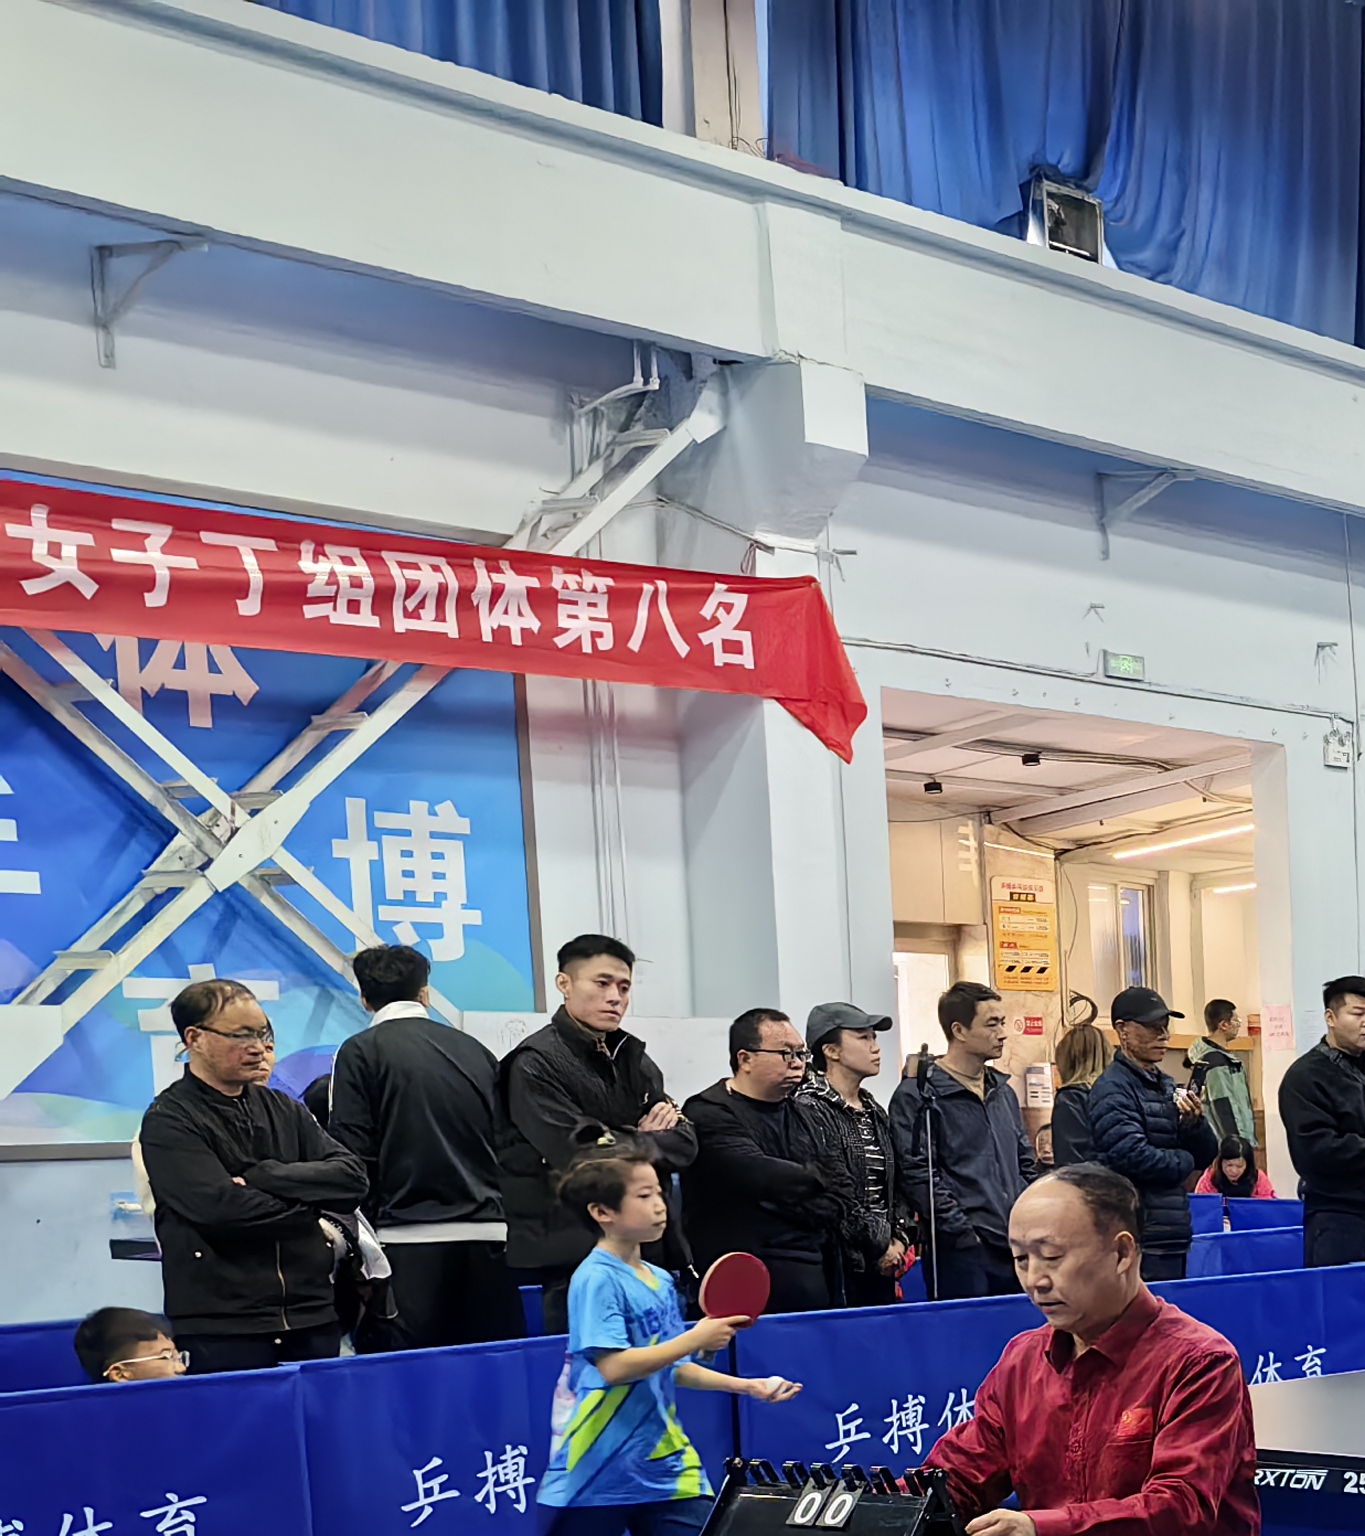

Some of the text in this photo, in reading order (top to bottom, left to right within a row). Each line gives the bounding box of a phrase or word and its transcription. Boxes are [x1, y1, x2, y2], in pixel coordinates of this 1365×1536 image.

[4, 503, 756, 671] 女子丁组团体第八名
